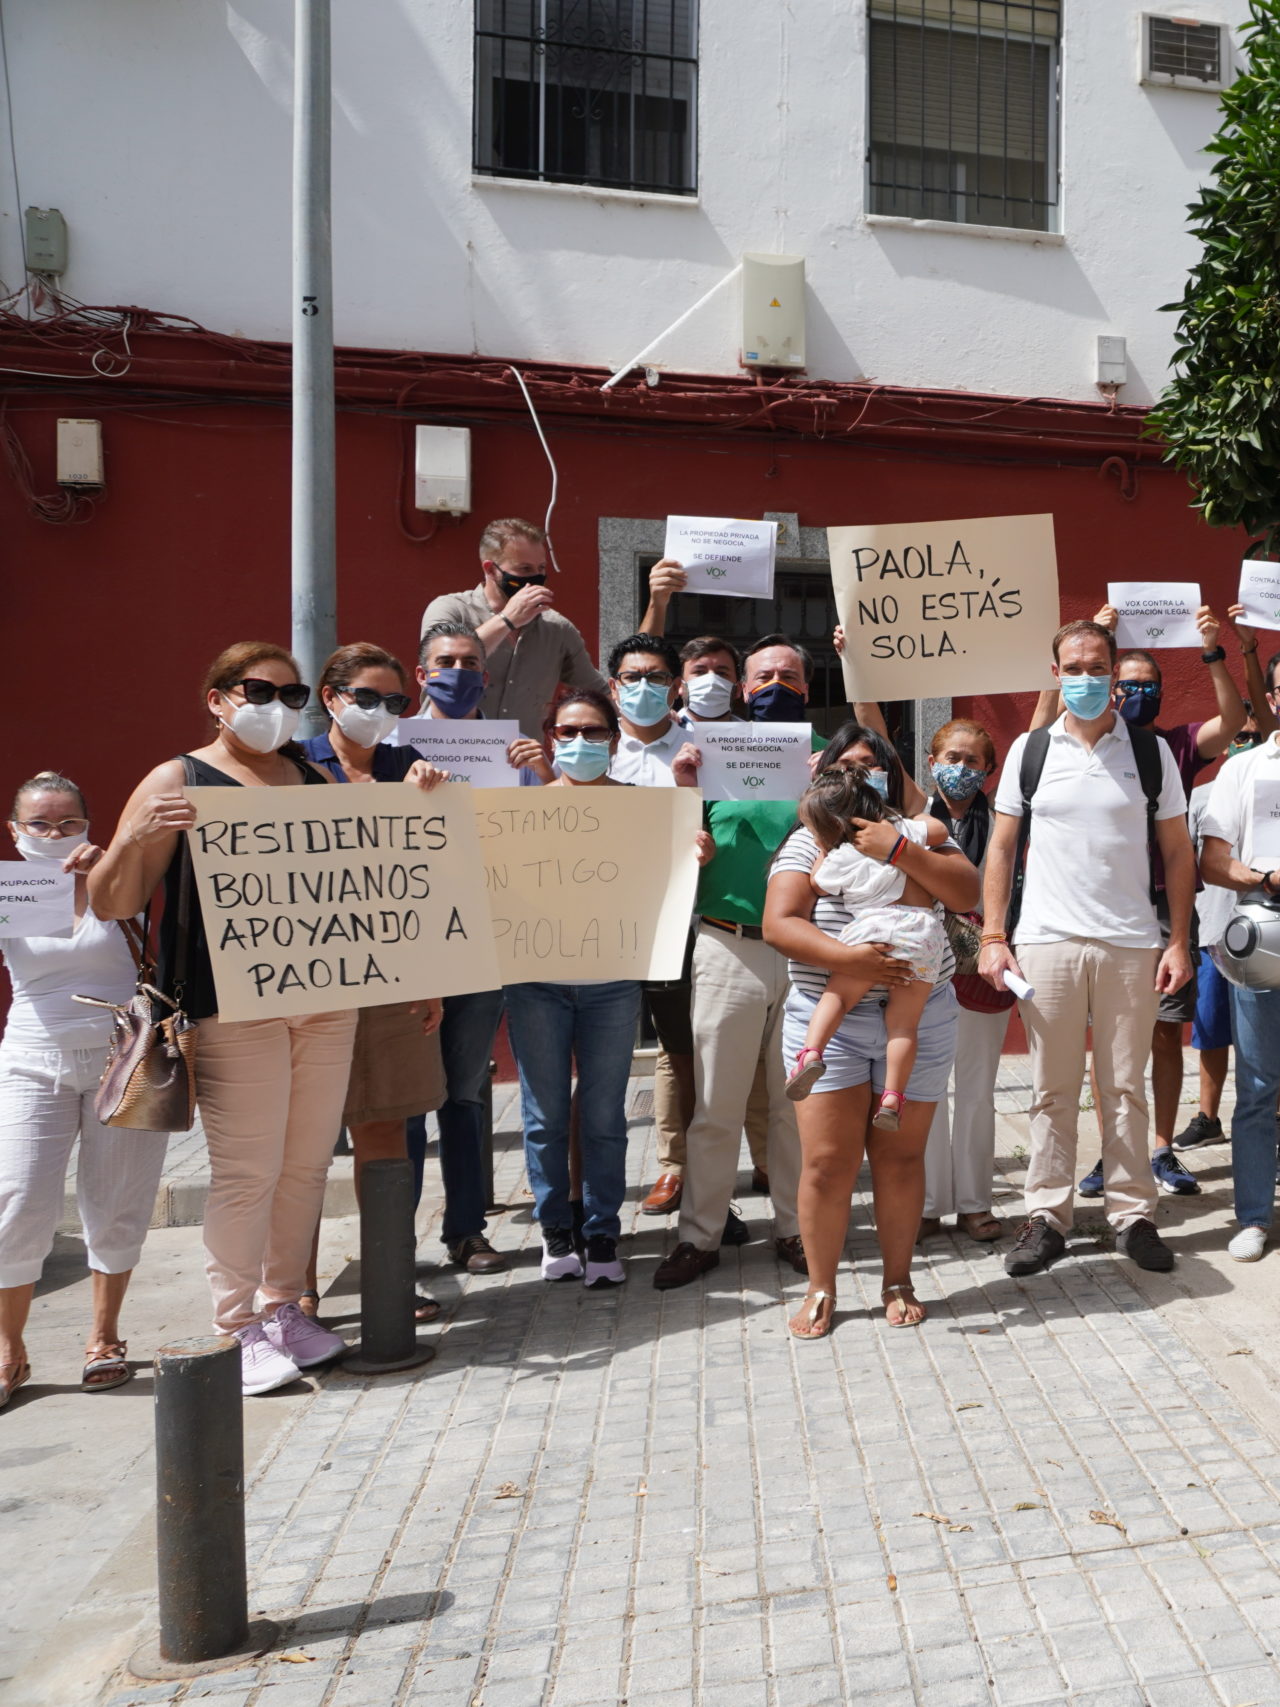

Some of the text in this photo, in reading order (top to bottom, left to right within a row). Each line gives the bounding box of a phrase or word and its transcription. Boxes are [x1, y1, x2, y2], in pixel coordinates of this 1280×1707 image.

[690, 530, 729, 538] PROPIEDAD
[704, 554, 743, 563] DEFIENDE
[852, 540, 984, 582] PAOLA,
[706, 567, 727, 577] VOX
[1249, 576, 1276, 584] CONTRA
[858, 577, 1022, 625] NO ESTÁS
[1119, 608, 1163, 616] OCUPACIÓN
[1146, 627, 1165, 637] VOX
[871, 631, 967, 659] SOLA.
[426, 754, 461, 763] CÓDIGO
[726, 761, 737, 769] SE
[742, 775, 766, 787] VOX
[196, 815, 447, 856] RESIDENTES
[522, 858, 619, 888] TIGO
[208, 864, 430, 908] BOLIVIANOS
[0, 895, 39, 903] PENAL
[220, 906, 468, 950] APOYANDO A
[247, 953, 400, 998] PAOLA.
